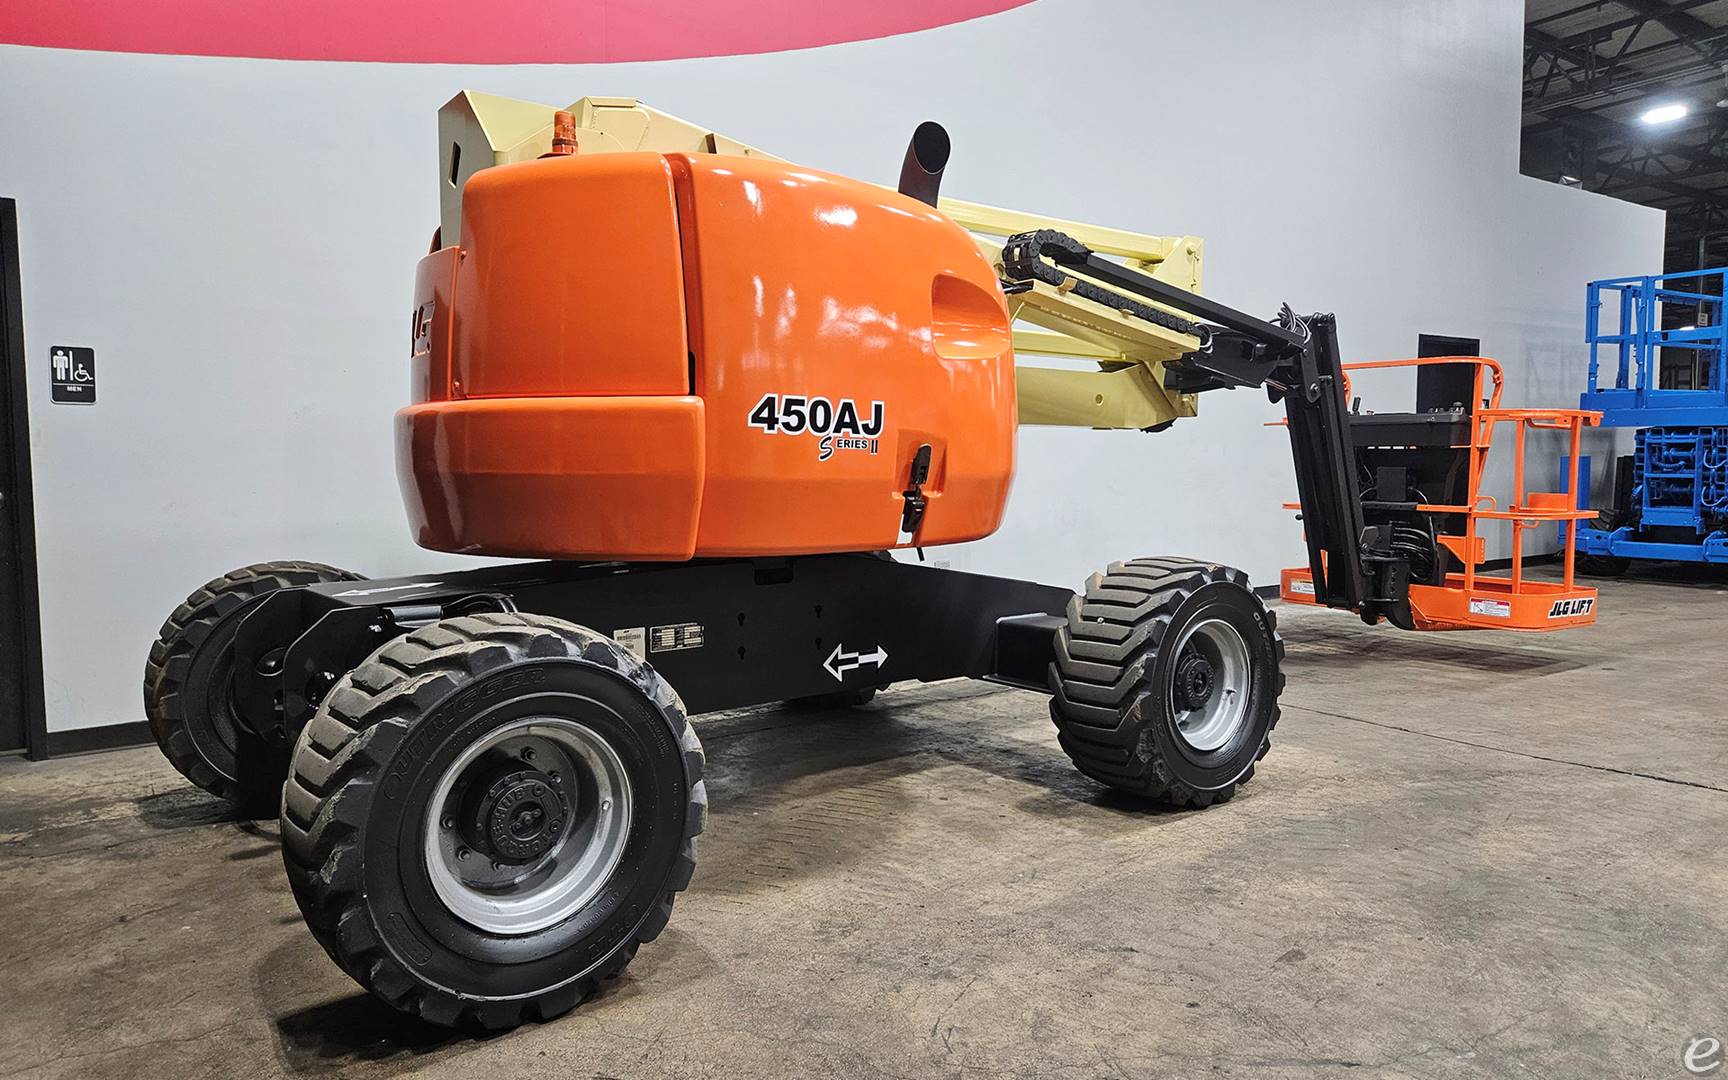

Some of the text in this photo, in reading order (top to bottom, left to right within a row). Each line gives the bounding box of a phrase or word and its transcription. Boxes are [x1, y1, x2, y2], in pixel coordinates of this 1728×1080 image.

[749, 395, 883, 437] 450AJ
[819, 435, 868, 460] SERIES
[1549, 599, 1593, 617] JLG LIFT
